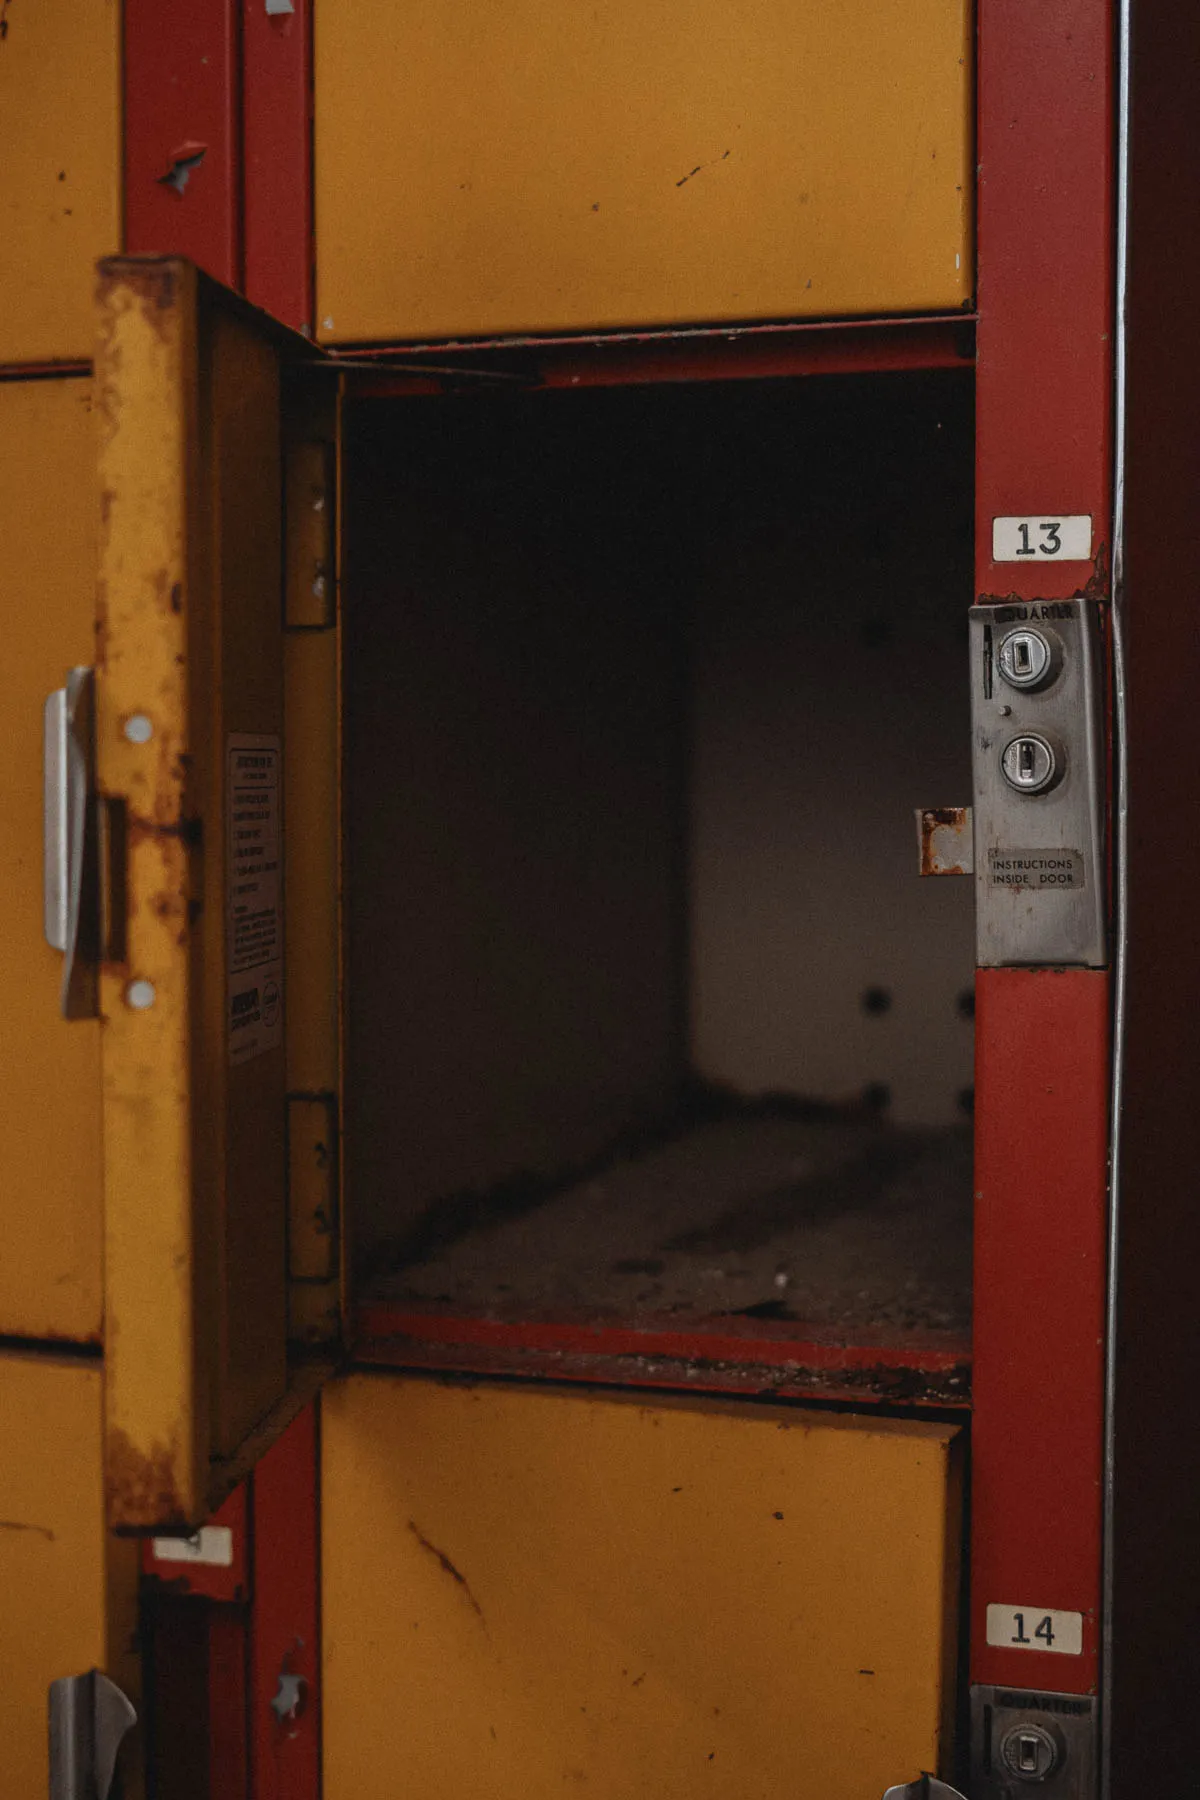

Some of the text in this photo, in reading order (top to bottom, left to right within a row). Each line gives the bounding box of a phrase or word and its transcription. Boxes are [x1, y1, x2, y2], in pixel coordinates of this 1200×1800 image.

[1016, 523, 1061, 555] 13
[993, 859, 1073, 870] INSTRUCTIONS
[993, 874, 1073, 884] INSIDE DOOR
[1011, 1612, 1055, 1646] 14
